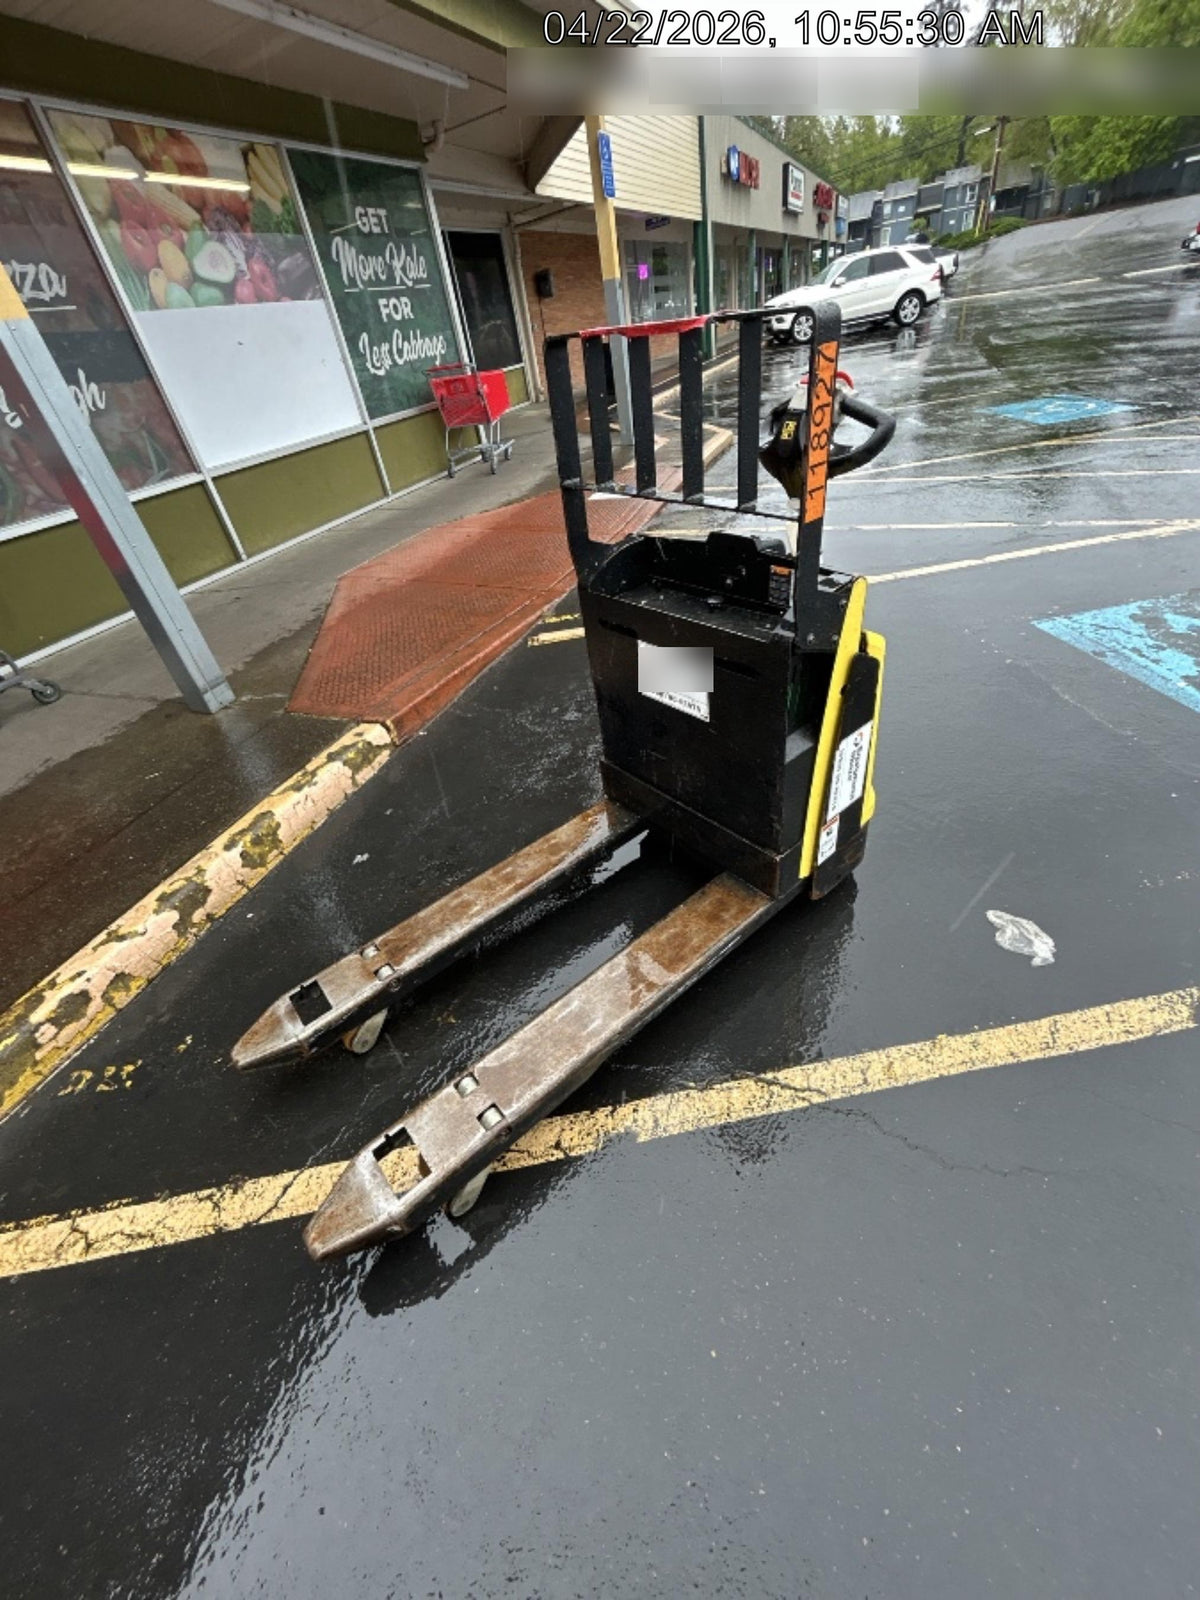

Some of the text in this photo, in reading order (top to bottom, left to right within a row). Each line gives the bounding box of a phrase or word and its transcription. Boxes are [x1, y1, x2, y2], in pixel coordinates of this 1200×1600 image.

[355, 205, 389, 234] GET
[331, 236, 428, 290] More Kale
[377, 296, 415, 323] FOR
[358, 328, 447, 376] Less Cabbage
